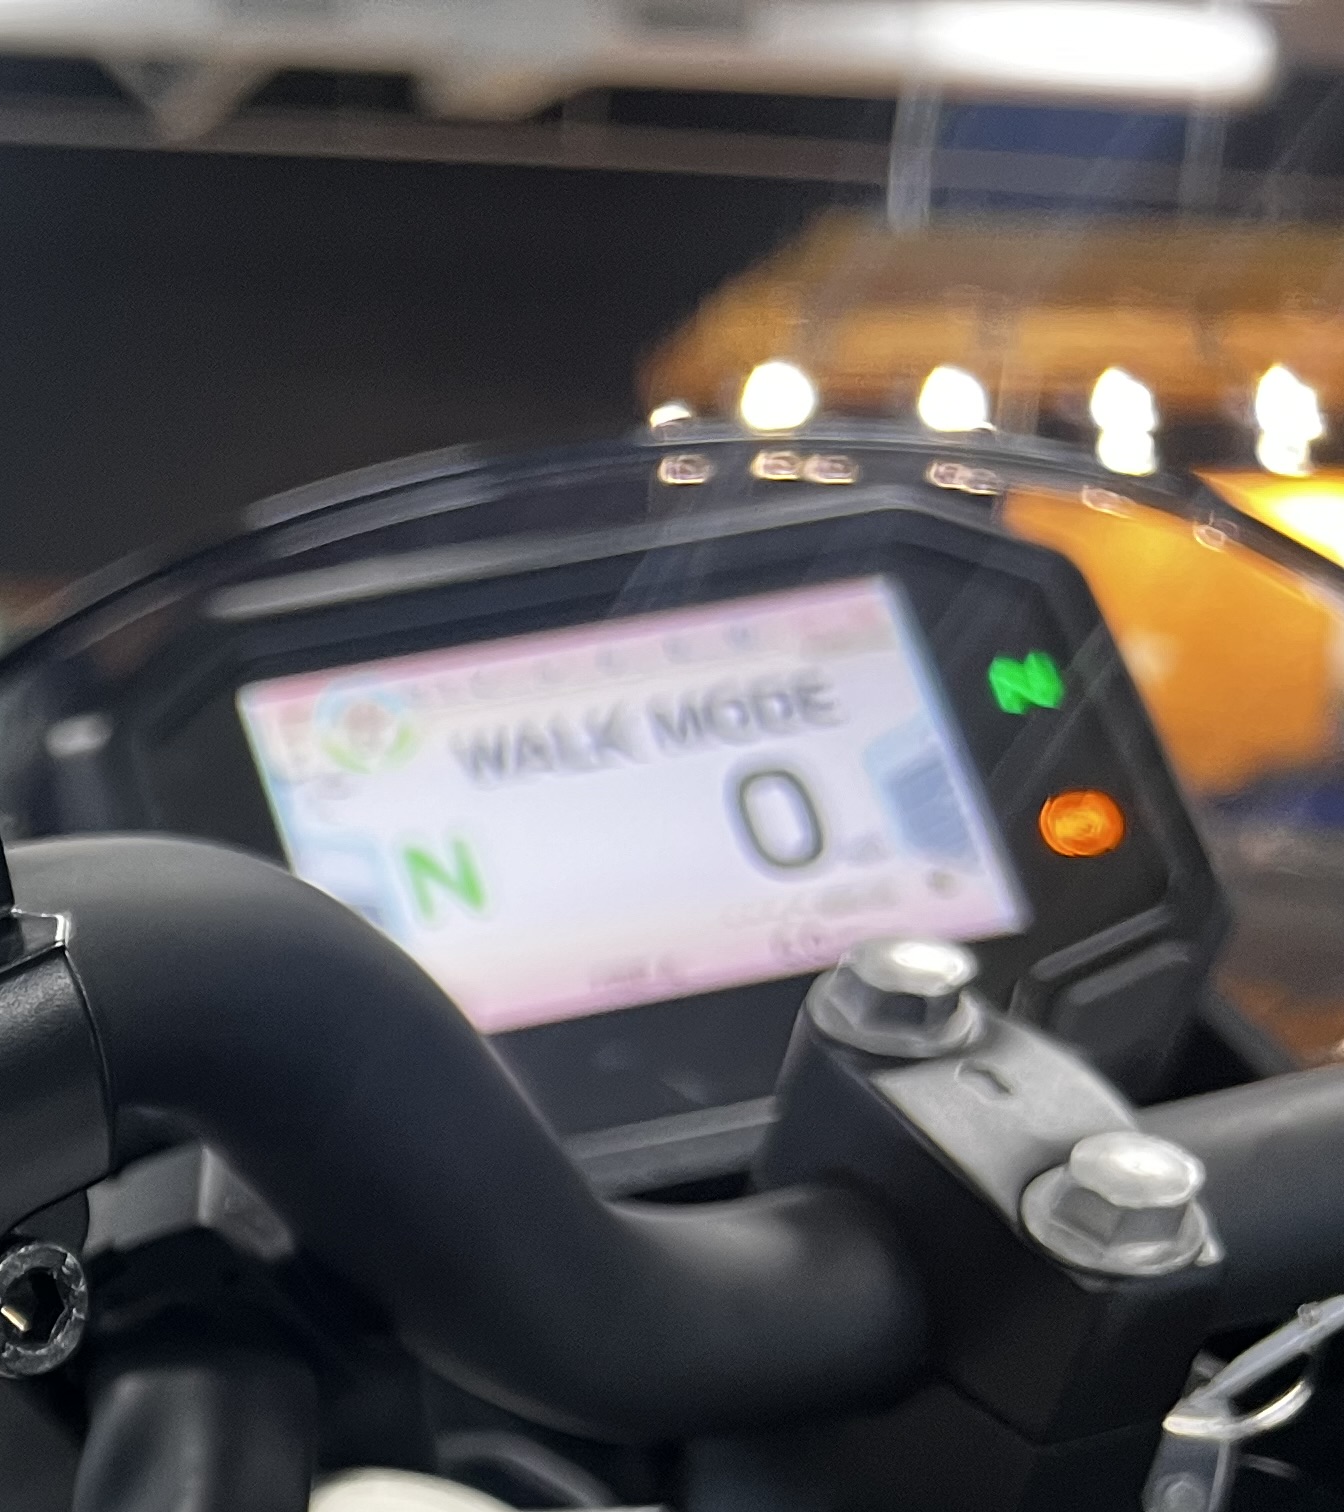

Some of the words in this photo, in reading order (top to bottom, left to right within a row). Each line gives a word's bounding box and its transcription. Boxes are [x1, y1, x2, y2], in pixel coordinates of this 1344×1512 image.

[988, 651, 1064, 714] N
[453, 708, 636, 784] WALK
[649, 669, 844, 747] MODE
[400, 834, 486, 920] N
